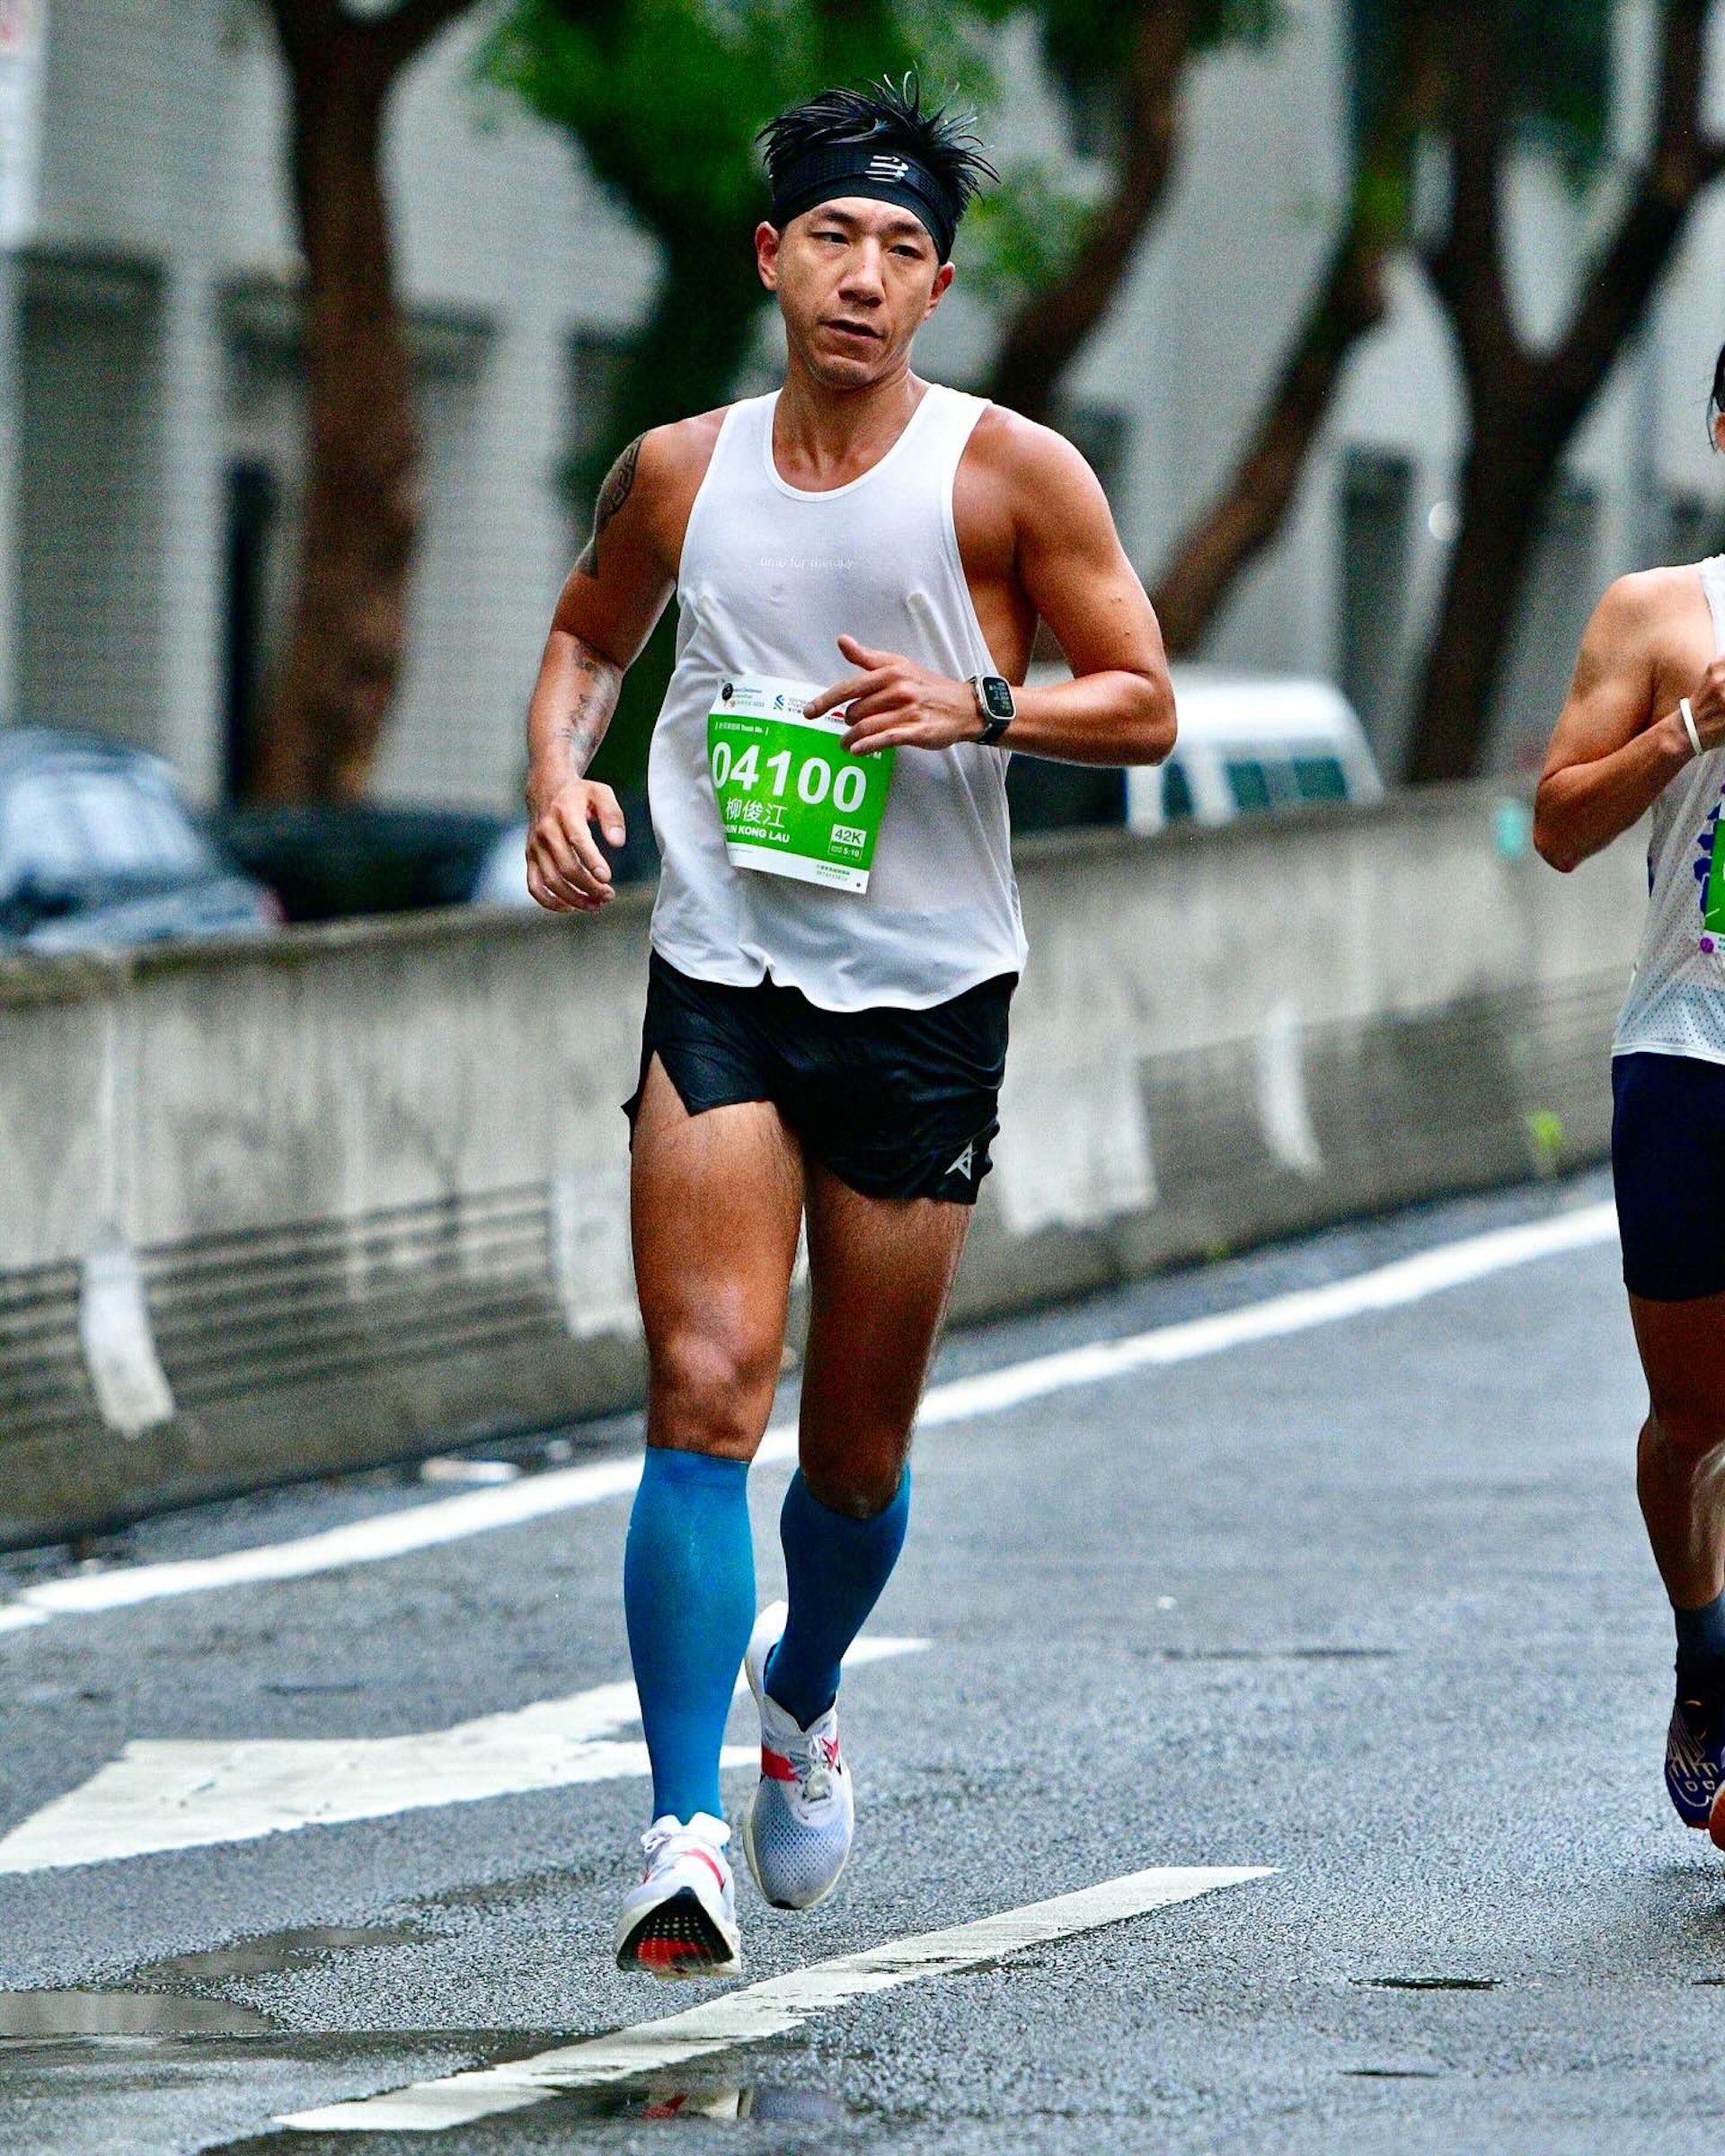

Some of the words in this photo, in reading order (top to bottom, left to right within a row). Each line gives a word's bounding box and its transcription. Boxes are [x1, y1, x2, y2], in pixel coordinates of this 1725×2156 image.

[712, 741, 867, 813] 04100
[725, 797, 788, 828] 柳俊江
[737, 825, 767, 839] KONG
[768, 829, 791, 844] LAU
[834, 828, 862, 844] 42K
